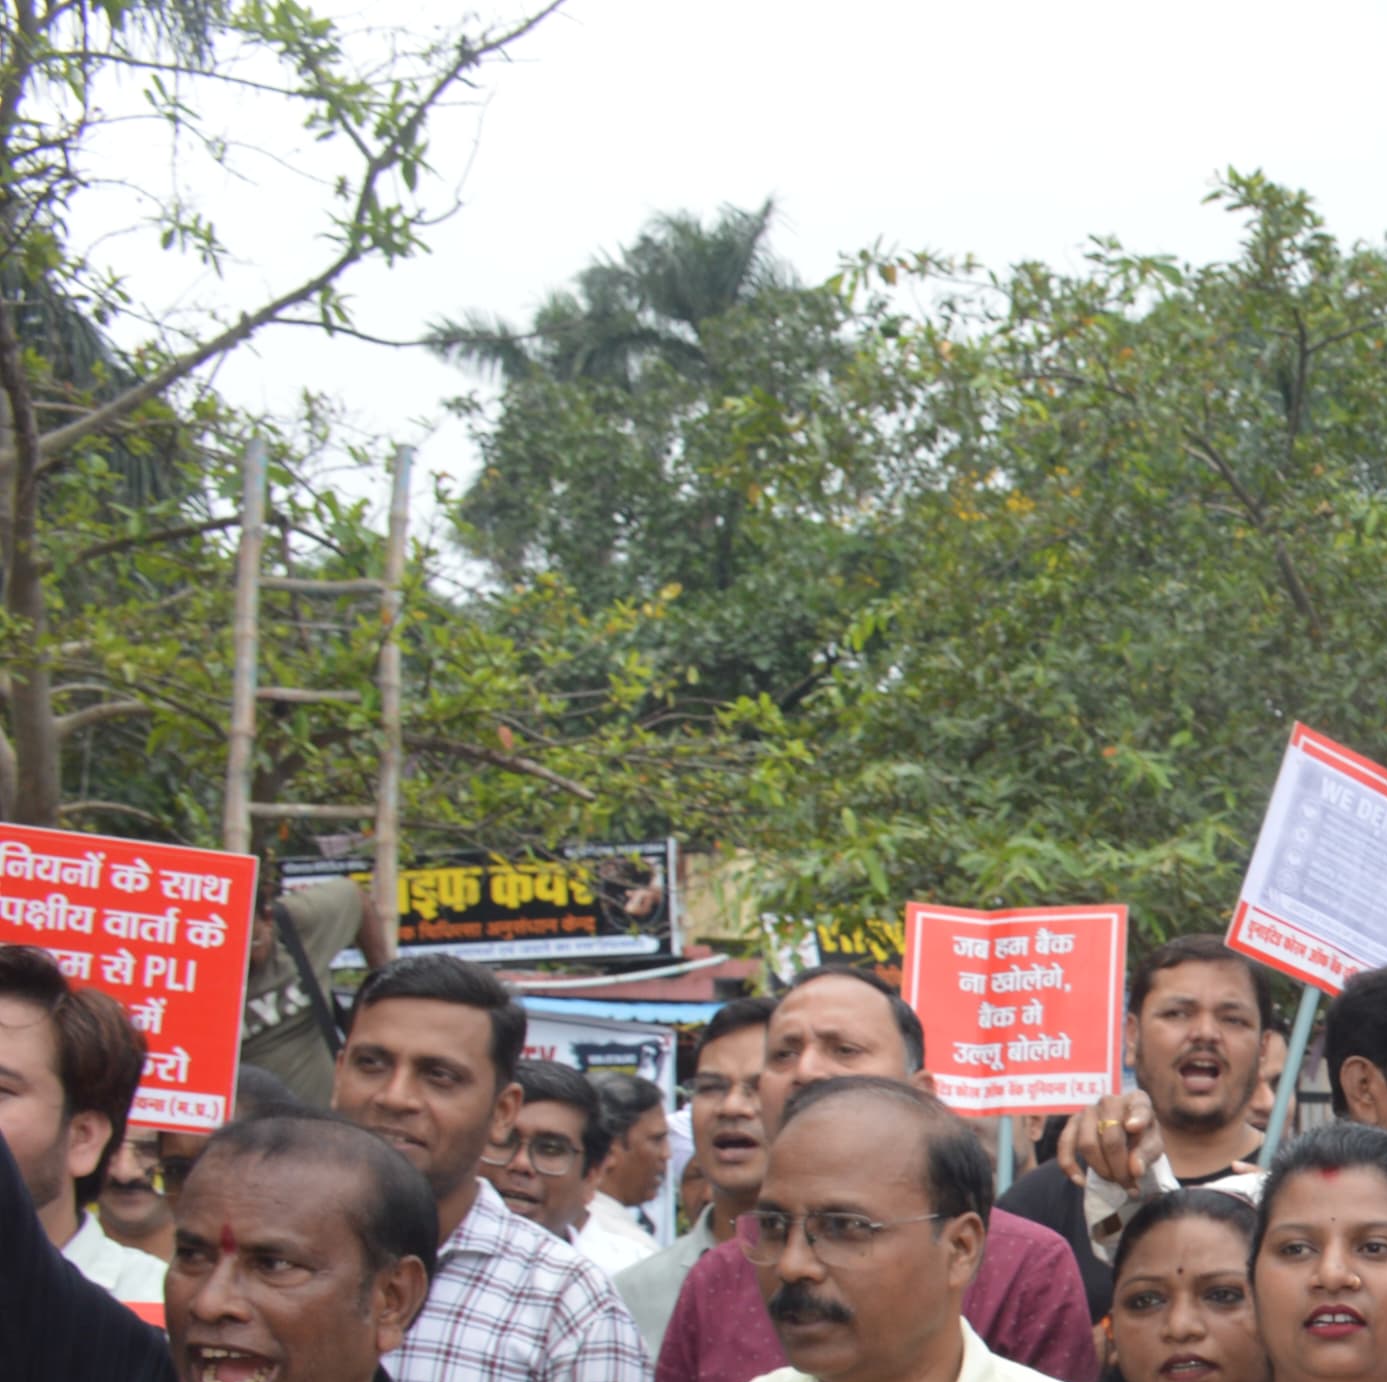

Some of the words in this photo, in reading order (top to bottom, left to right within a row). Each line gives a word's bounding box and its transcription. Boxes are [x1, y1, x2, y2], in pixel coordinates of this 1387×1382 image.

[1321, 776, 1355, 811] WE
[0, 841, 105, 890] नियनों
[111, 858, 152, 893] के
[159, 869, 232, 905] साथ
[0, 893, 95, 938] पक्षीय
[104, 907, 180, 944] वार्ता
[187, 913, 228, 949] के
[953, 935, 990, 961] जब
[994, 935, 1030, 959] हम
[101, 948, 136, 985] से
[144, 955, 197, 992] PLI
[959, 970, 987, 995] ना
[952, 1040, 1005, 1072] उल्लू
